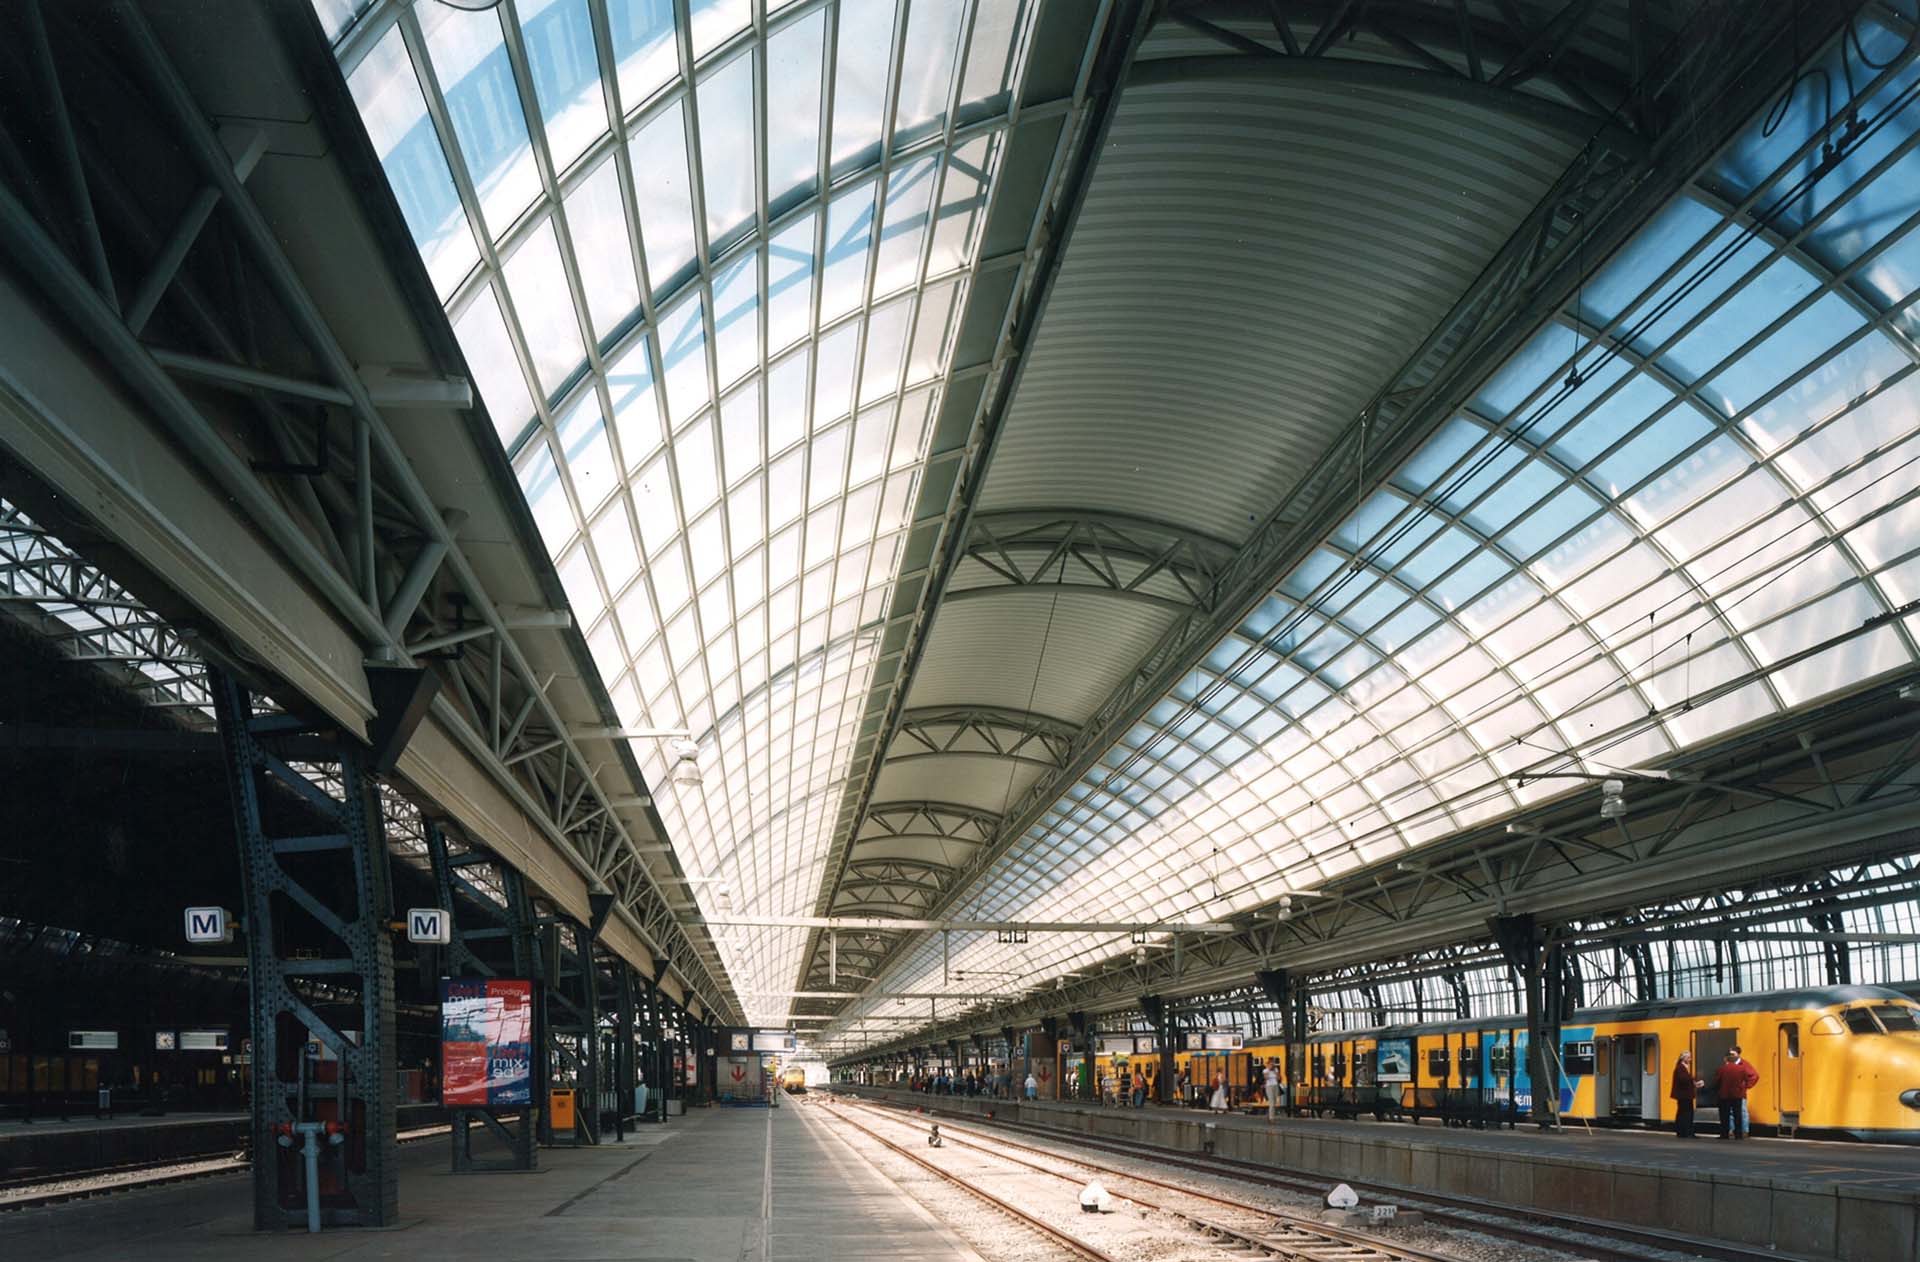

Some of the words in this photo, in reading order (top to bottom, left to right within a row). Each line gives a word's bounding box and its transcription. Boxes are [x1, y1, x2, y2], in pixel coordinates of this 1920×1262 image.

[192, 915, 217, 934] M
[414, 916, 437, 935] M
[493, 1058, 523, 1068] mix
